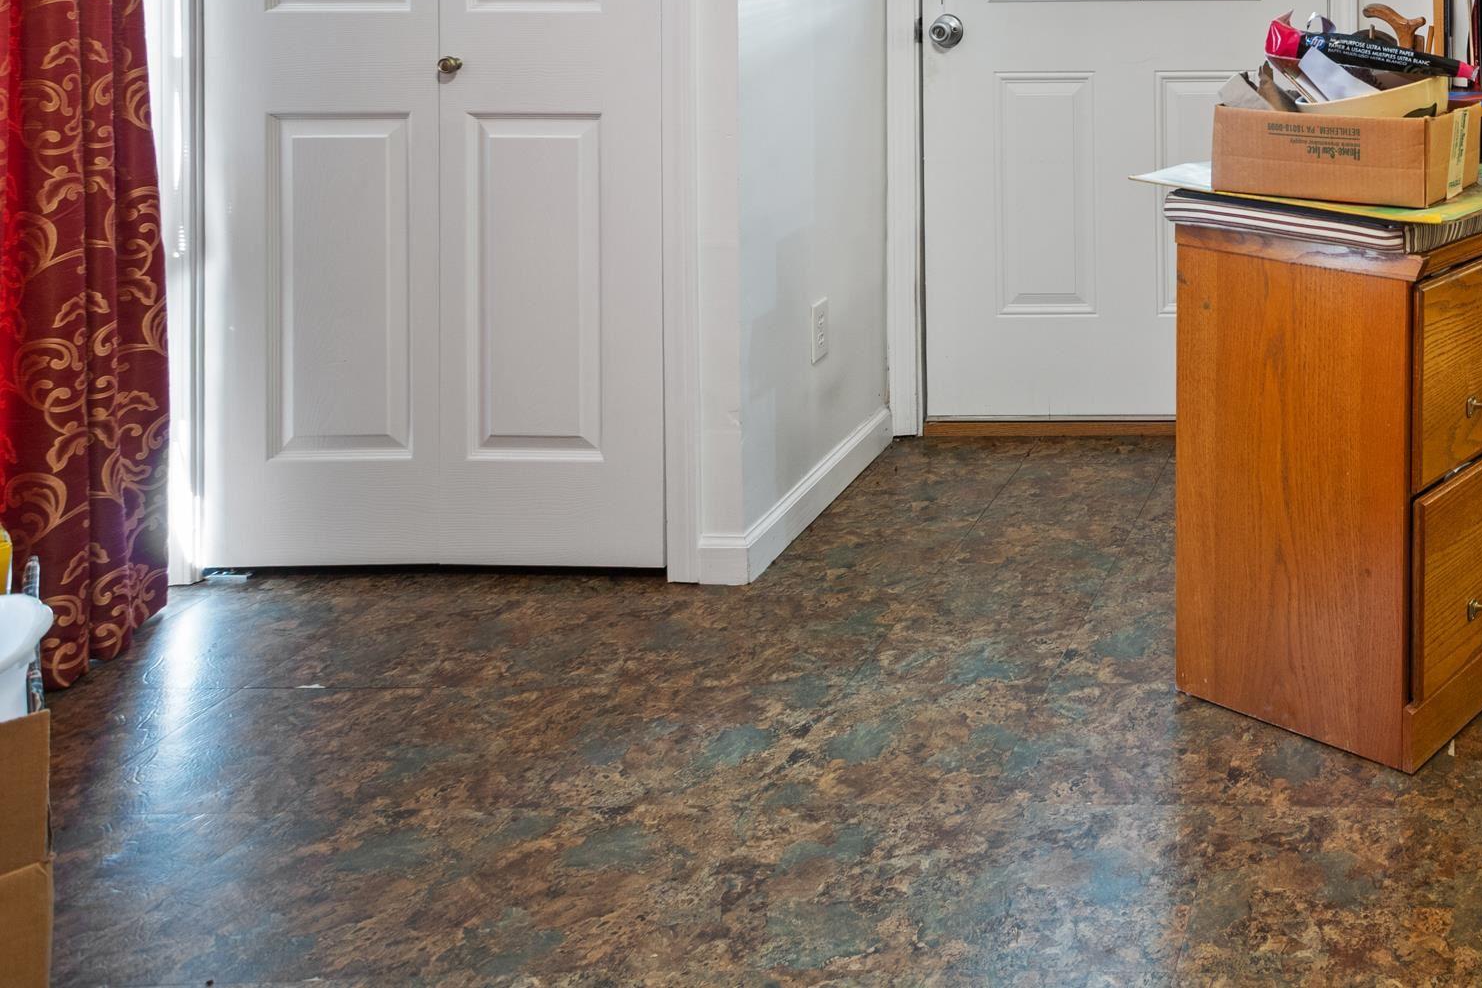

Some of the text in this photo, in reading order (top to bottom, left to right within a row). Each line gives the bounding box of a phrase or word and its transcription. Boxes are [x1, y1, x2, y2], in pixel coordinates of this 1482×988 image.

[1310, 35, 1324, 48] hp
[1351, 47, 1370, 55] USAGES
[1372, 50, 1396, 60] MULTIPLES
[1397, 55, 1412, 63] ULTRA
[1366, 43, 1381, 51] ULTRA
[1382, 46, 1398, 54] WHITE
[1399, 49, 1415, 57] PAPER
